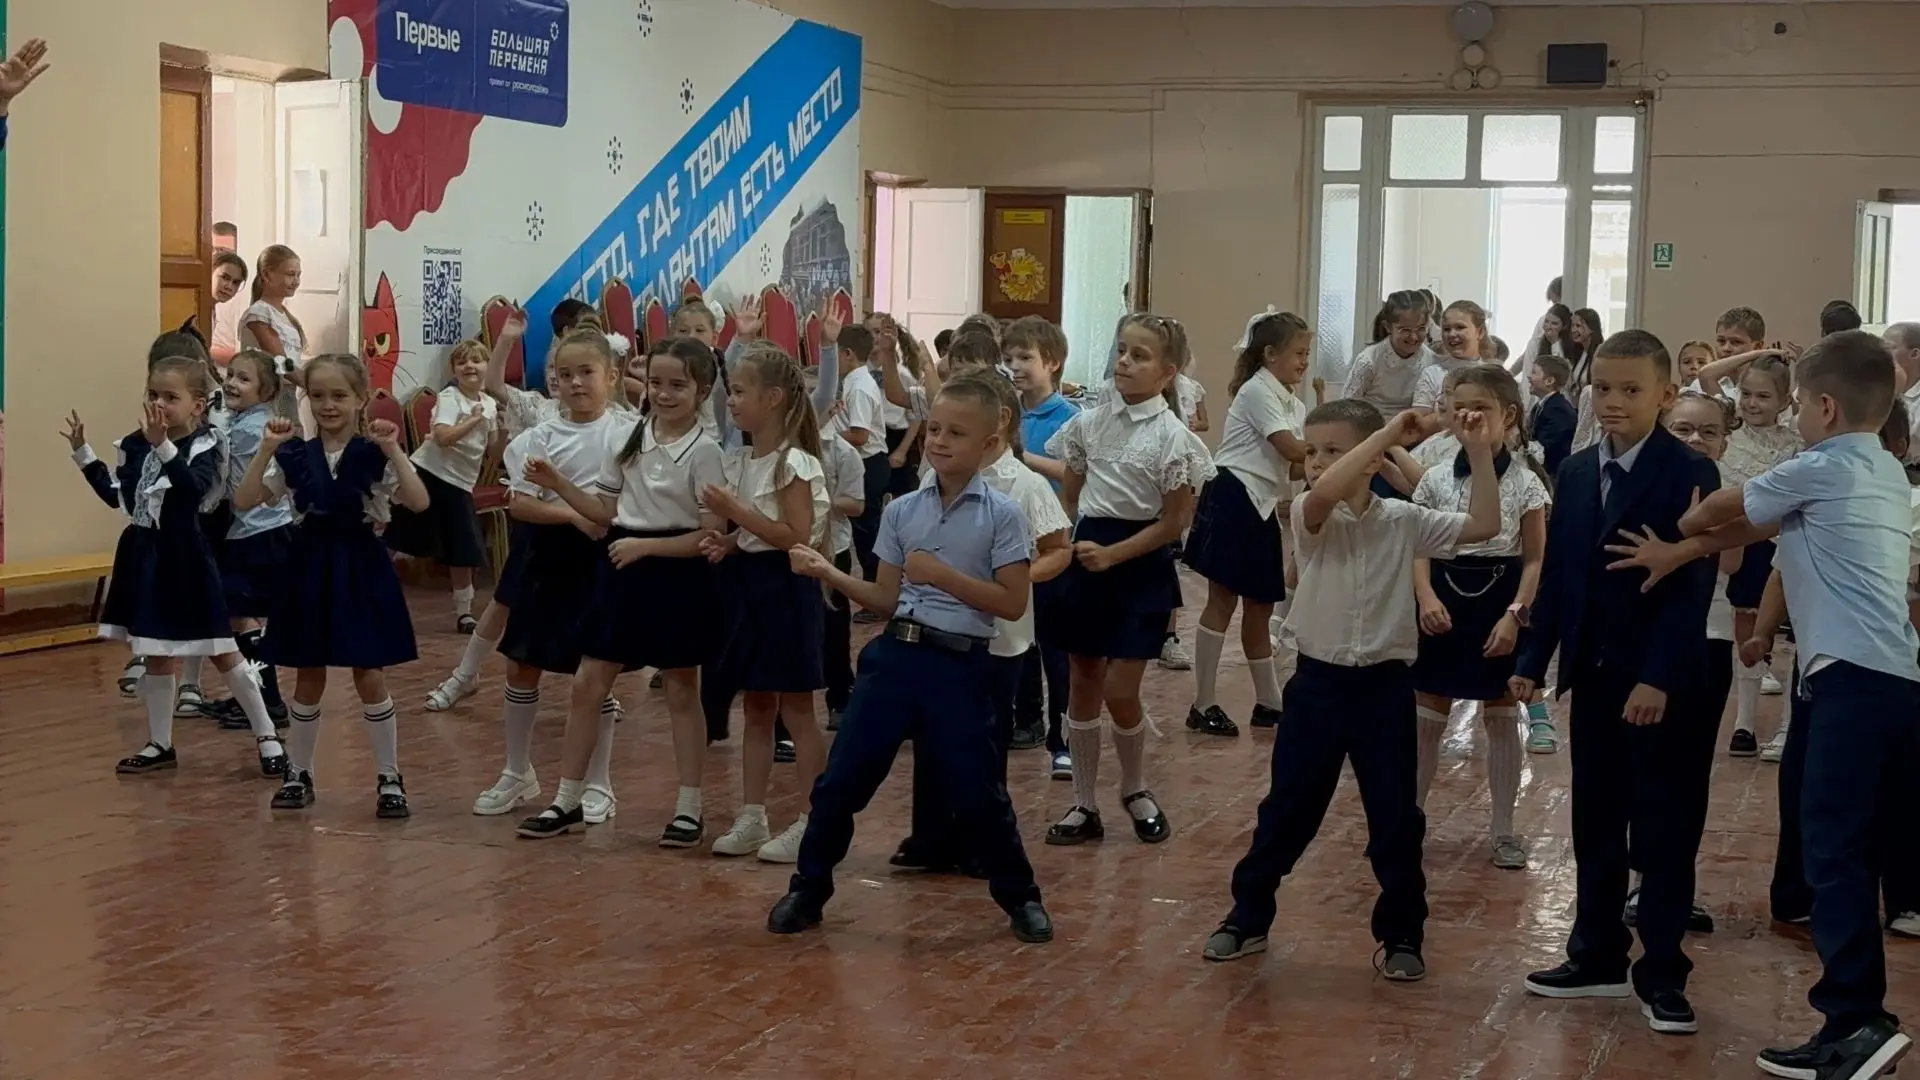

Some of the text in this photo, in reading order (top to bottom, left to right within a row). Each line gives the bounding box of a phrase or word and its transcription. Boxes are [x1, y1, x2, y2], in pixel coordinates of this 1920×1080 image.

[395, 11, 461, 54] Первые
[491, 29, 550, 56] БОЛЬШАЯ
[489, 50, 548, 76] ПЕРЕМЕНА
[740, 141, 785, 219] ЕСТЬ
[788, 66, 843, 163] МЕСТО
[637, 173, 681, 258] ГДЕ
[684, 95, 751, 199] ТВОИМ
